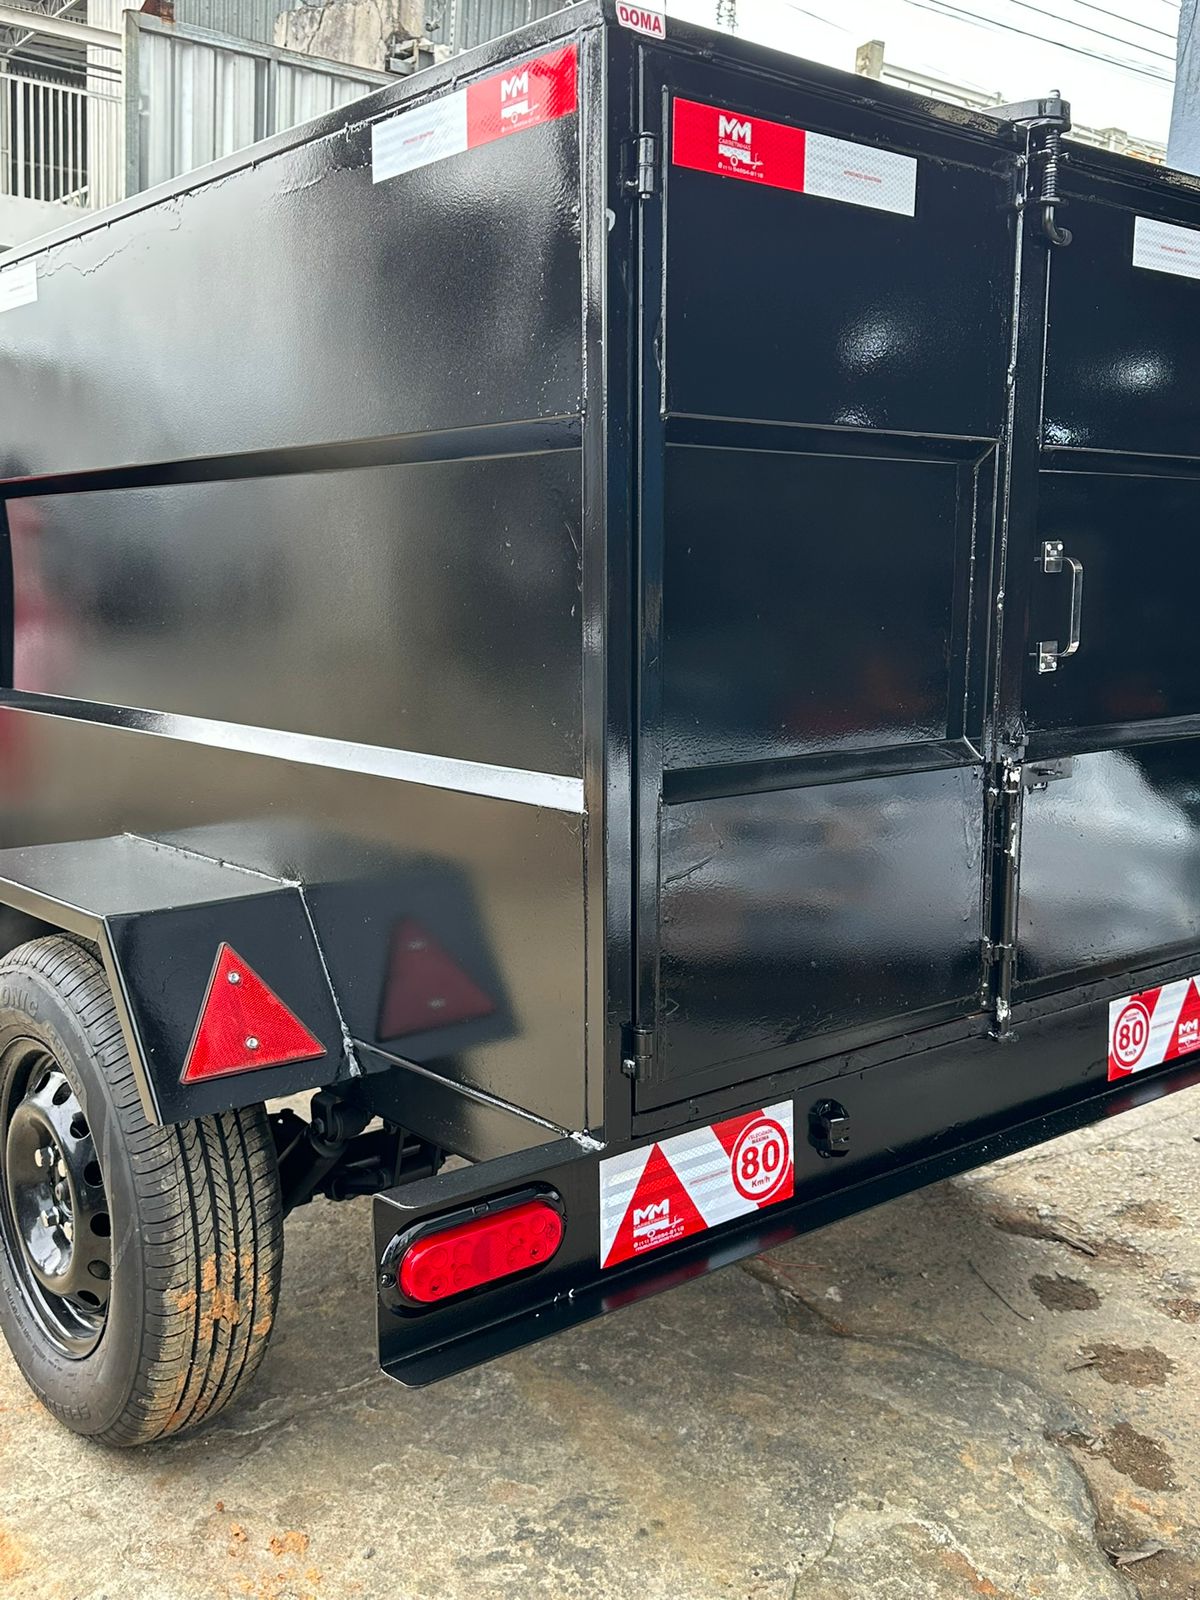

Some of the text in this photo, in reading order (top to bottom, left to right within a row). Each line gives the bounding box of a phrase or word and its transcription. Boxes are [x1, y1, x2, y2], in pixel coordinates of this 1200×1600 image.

[500, 71, 529, 102] MM
[718, 114, 752, 145] MM
[1119, 1020, 1144, 1050] 80
[741, 1139, 780, 1180] 80
[633, 1198, 670, 1225] MM
